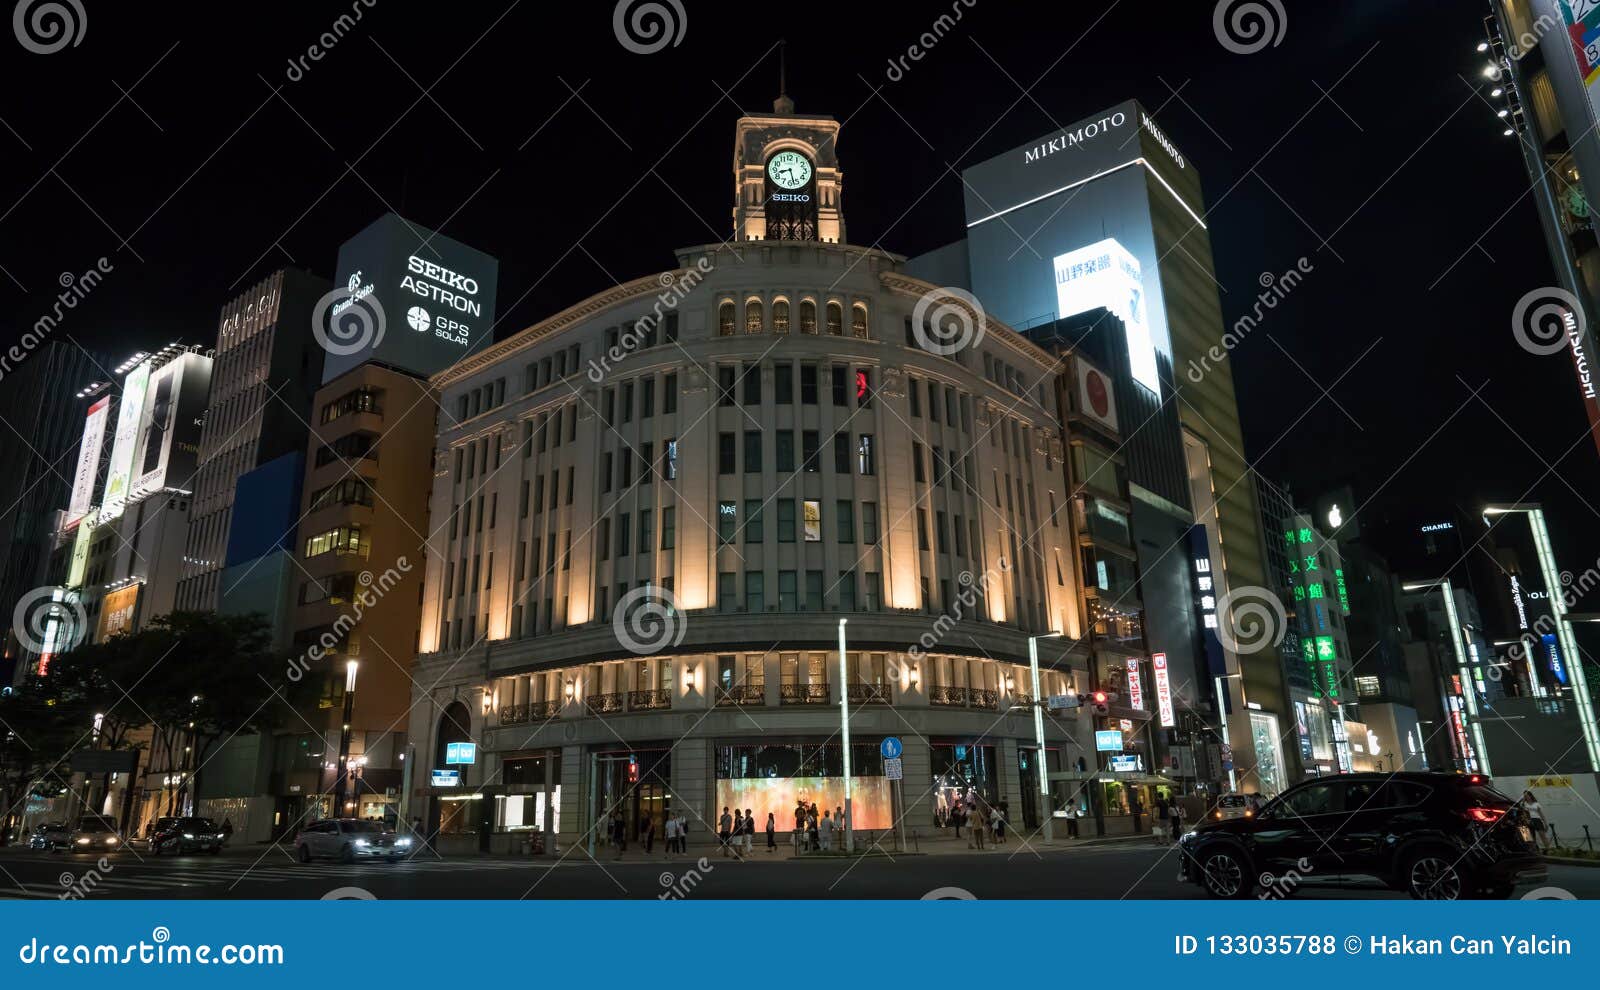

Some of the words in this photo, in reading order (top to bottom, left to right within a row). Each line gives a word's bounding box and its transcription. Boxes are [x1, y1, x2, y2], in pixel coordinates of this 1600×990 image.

[1025, 112, 1125, 164] MIKIMOTO
[1141, 112, 1185, 169] MIKIMOTO
[772, 194, 810, 202] SEIKO
[348, 270, 363, 293] GS
[407, 255, 479, 295] SEIKO
[332, 296, 355, 317] Grand
[355, 283, 374, 302] Seiko
[400, 275, 481, 318] ASTRON
[435, 330, 468, 346] SOLAR
[436, 316, 470, 337] GPS
[1421, 522, 1454, 532] CHANEL
[1527, 591, 1549, 599] OL
